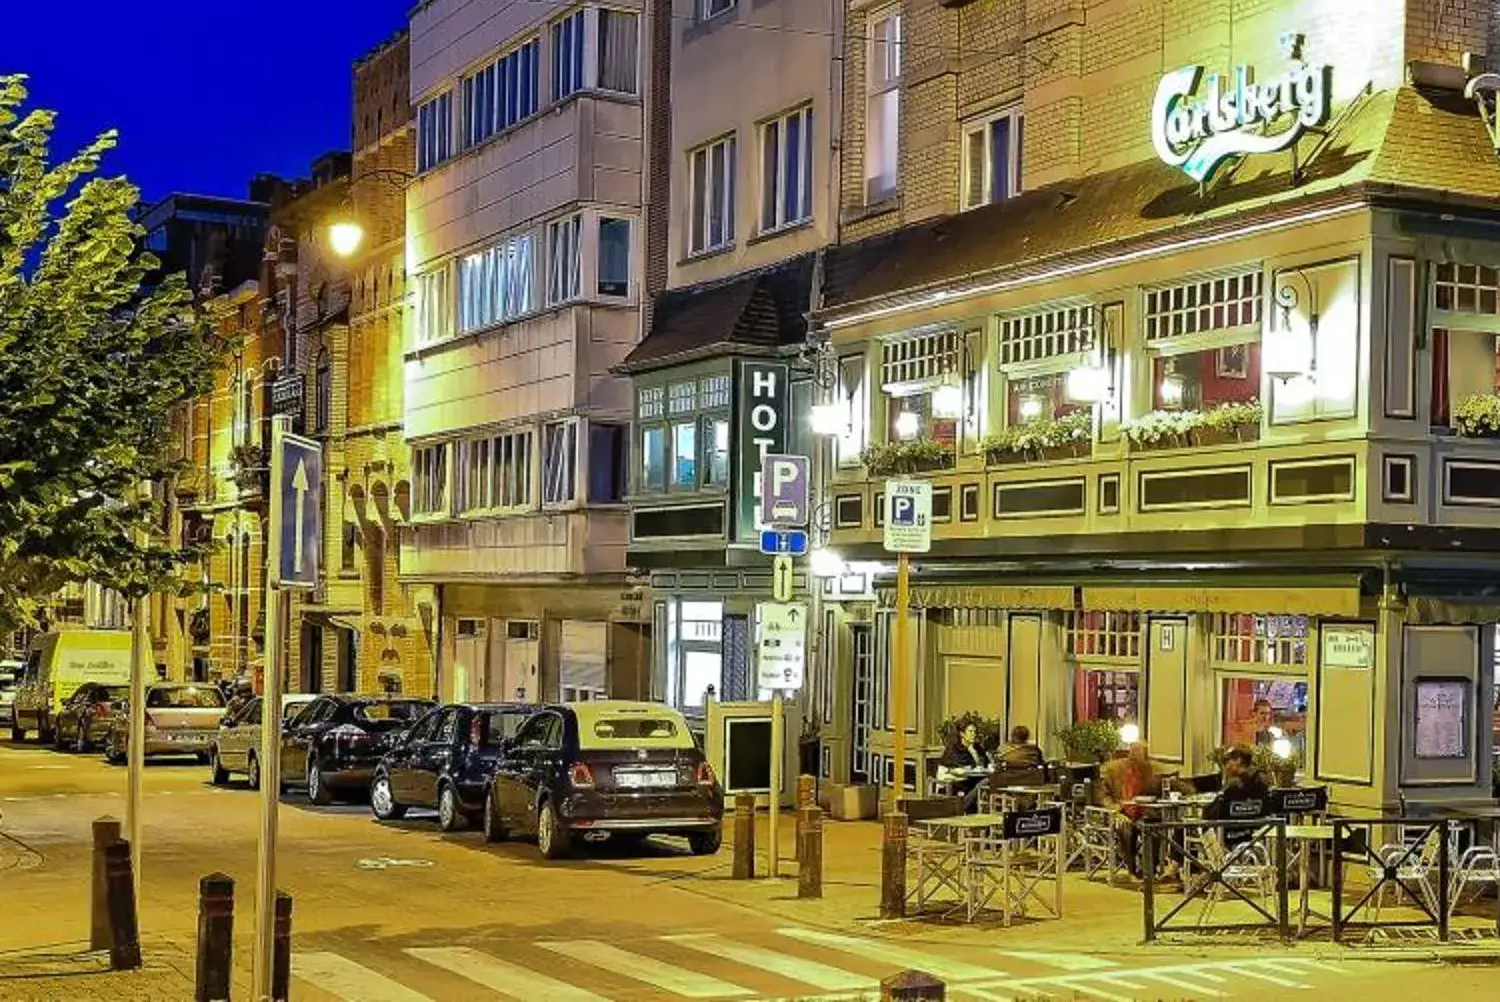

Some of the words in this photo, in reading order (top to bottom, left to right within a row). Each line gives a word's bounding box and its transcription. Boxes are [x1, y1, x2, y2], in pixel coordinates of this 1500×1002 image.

[1152, 61, 1329, 170] Carlsberg
[773, 460, 800, 497] P
[895, 497, 911, 519] P
